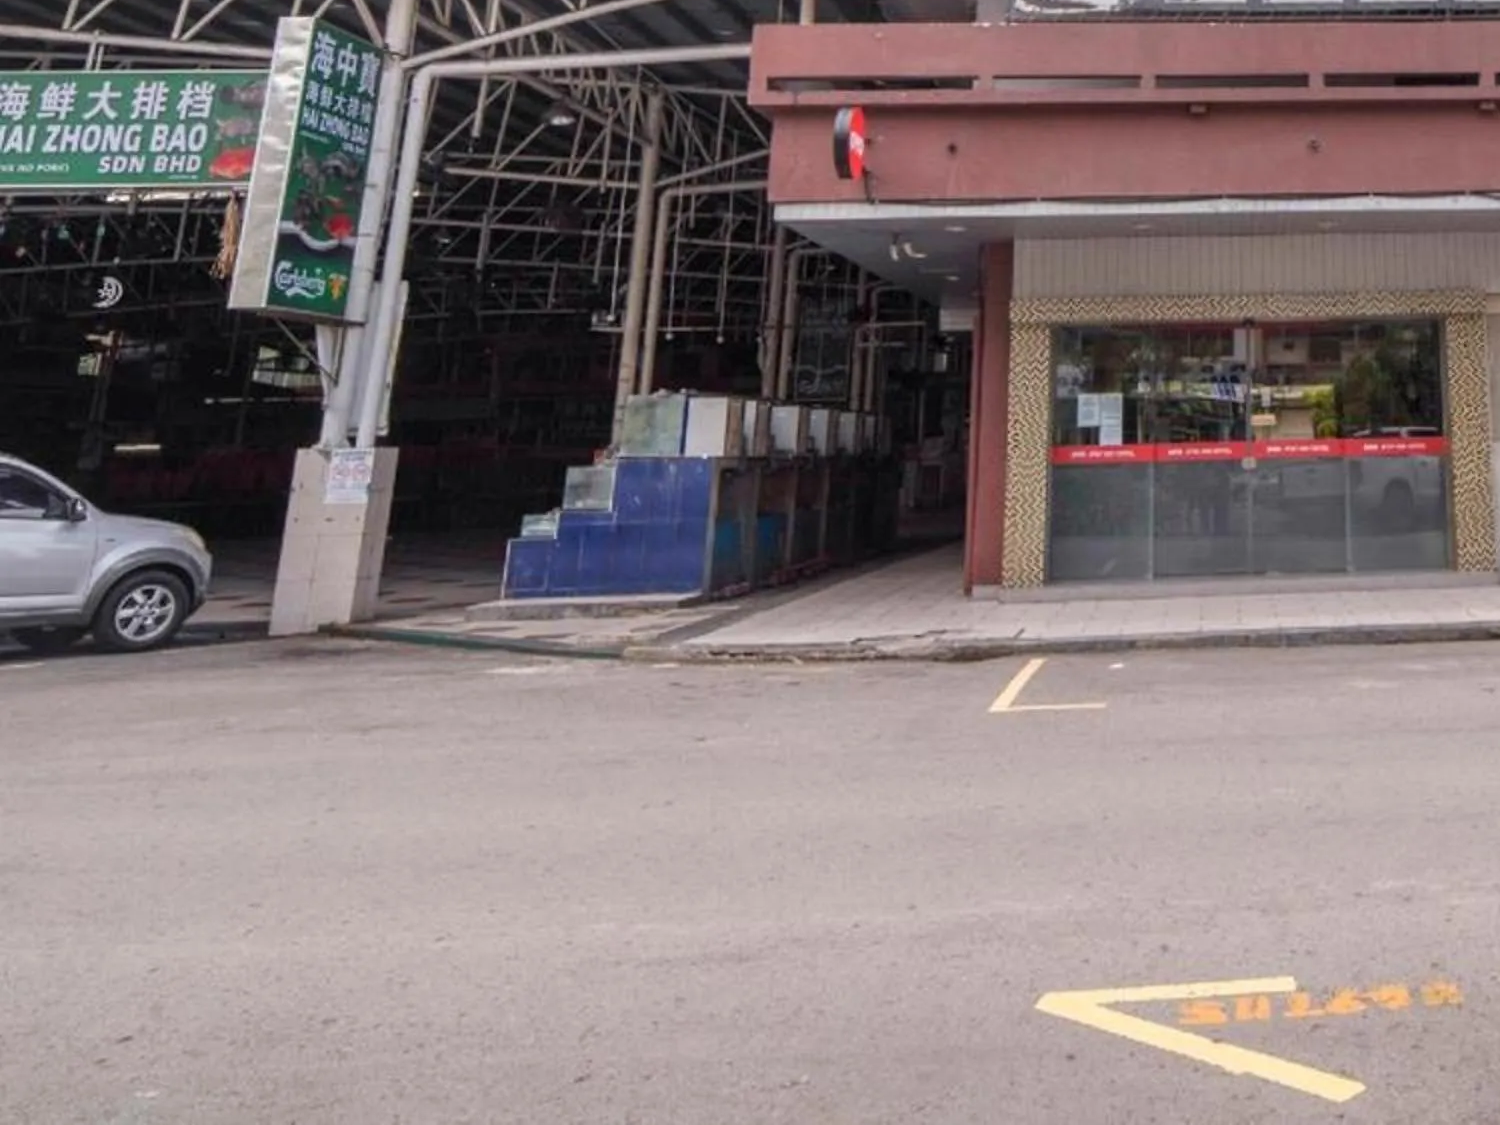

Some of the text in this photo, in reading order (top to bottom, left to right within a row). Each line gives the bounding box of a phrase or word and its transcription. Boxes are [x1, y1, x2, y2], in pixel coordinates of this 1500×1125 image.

[0, 124, 208, 154] AI ZHONG BAO
[97, 154, 202, 174] SDN BHD
[274, 260, 326, 299] Carlsberg
